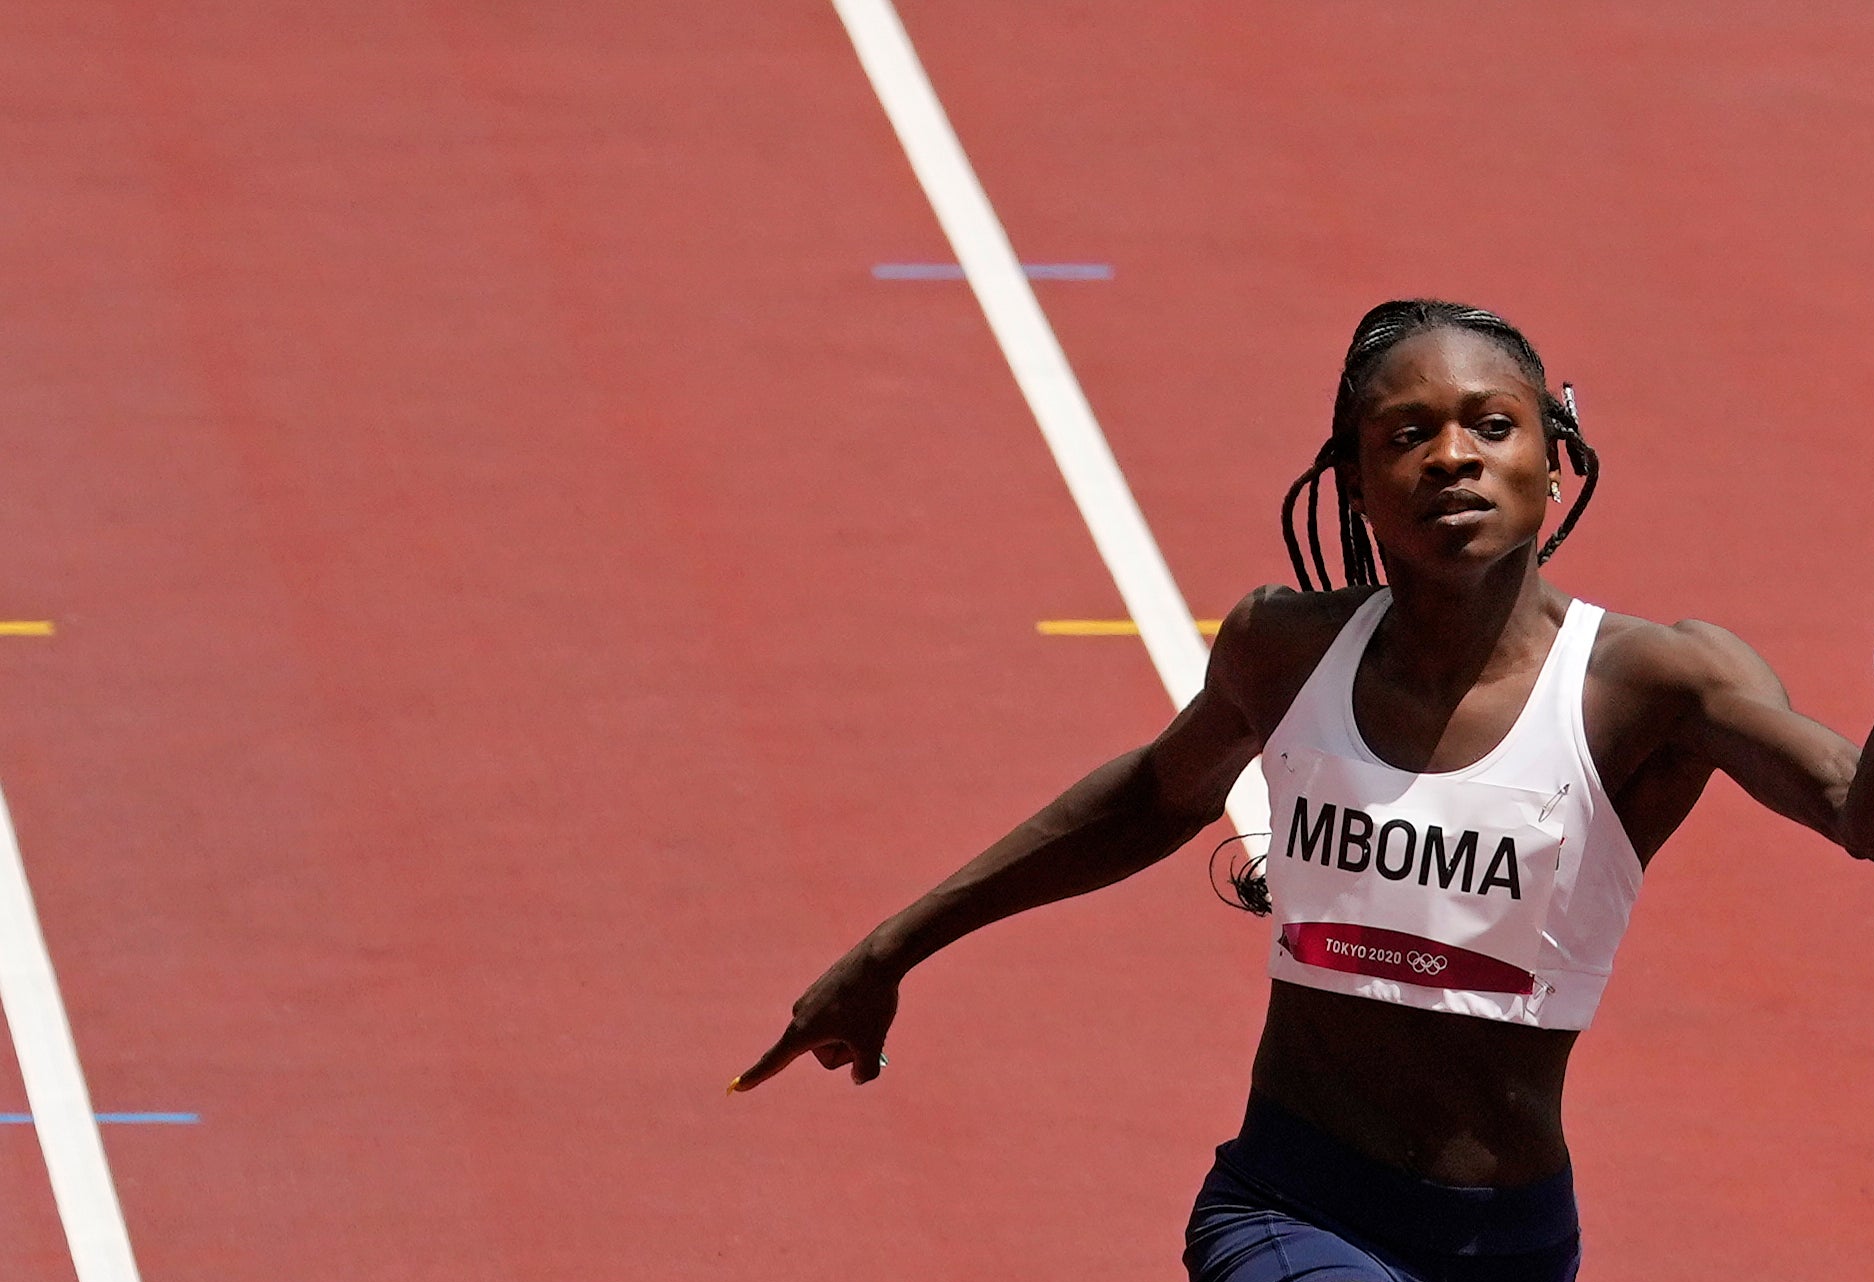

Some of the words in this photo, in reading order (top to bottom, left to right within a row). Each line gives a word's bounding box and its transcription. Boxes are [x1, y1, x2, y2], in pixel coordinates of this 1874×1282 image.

[1286, 796, 1521, 900] MBOMA
[1326, 938, 1367, 959] TOKYO
[1368, 947, 1402, 965] 2020
